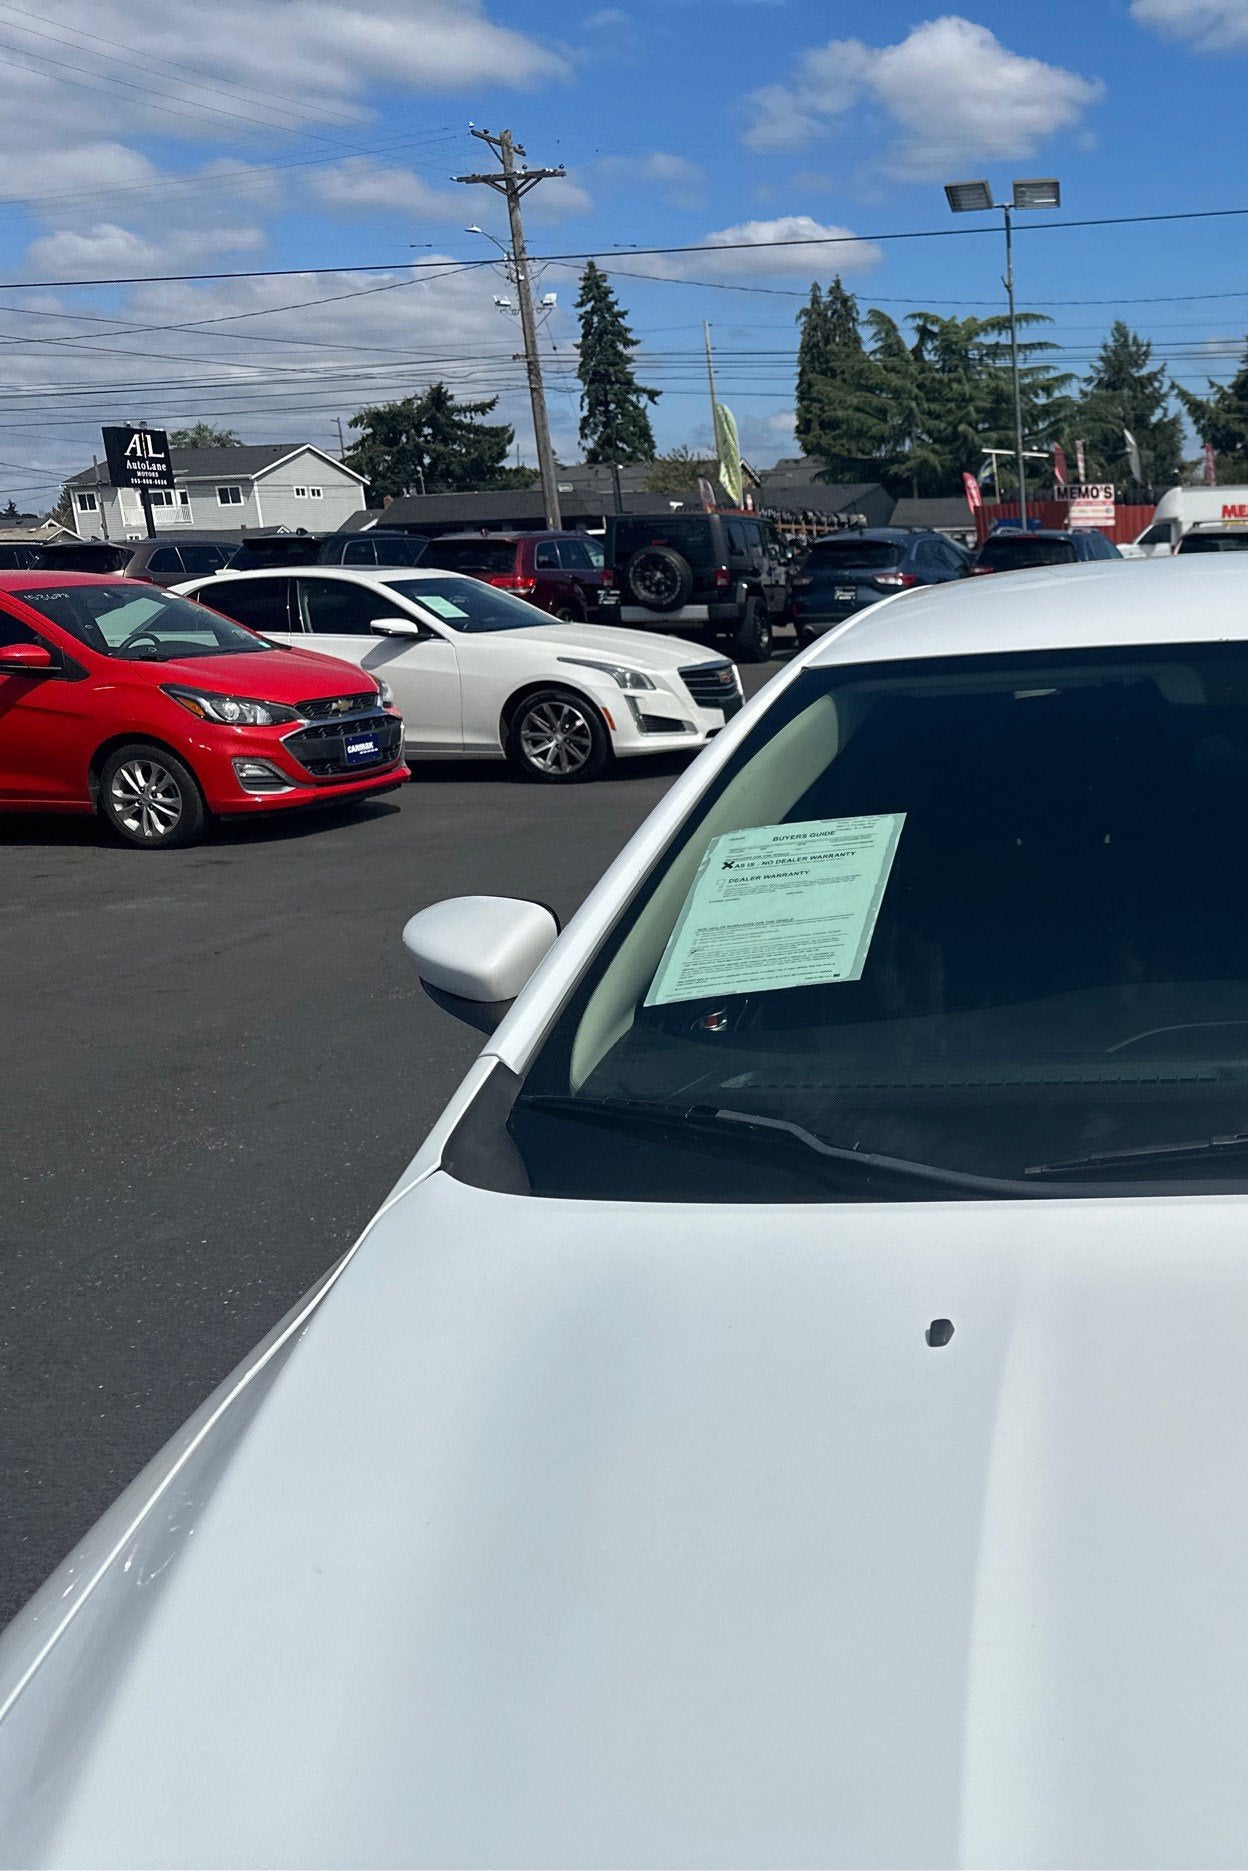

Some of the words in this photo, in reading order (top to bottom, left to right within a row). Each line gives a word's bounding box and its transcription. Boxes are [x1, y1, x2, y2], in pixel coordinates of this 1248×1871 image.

[126, 460, 167, 472] AutoLane
[1057, 485, 1113, 499] MEMO'S
[772, 832, 807, 842] BUYERS
[809, 830, 837, 838] GUIDE
[775, 856, 808, 865] DEALER
[810, 851, 857, 861] WARRANTY
[728, 875, 762, 884] DEALER
[763, 870, 810, 880] WARRANTY
